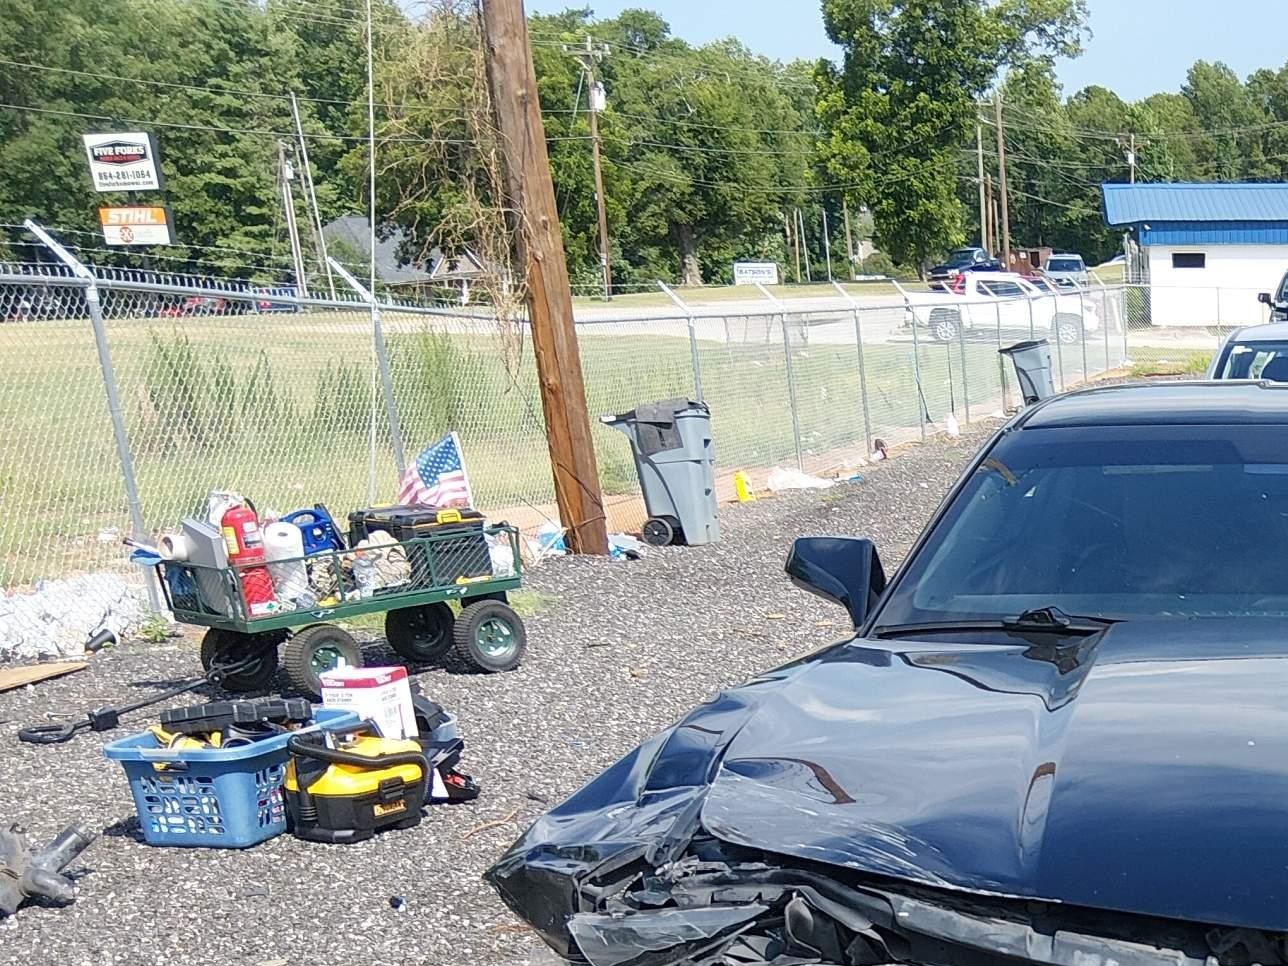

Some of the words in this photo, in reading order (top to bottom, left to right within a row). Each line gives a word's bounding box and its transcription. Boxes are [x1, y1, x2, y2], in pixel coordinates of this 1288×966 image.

[93, 146, 114, 156] FIVE
[114, 146, 145, 155] FORKS
[108, 208, 157, 224] STIHL
